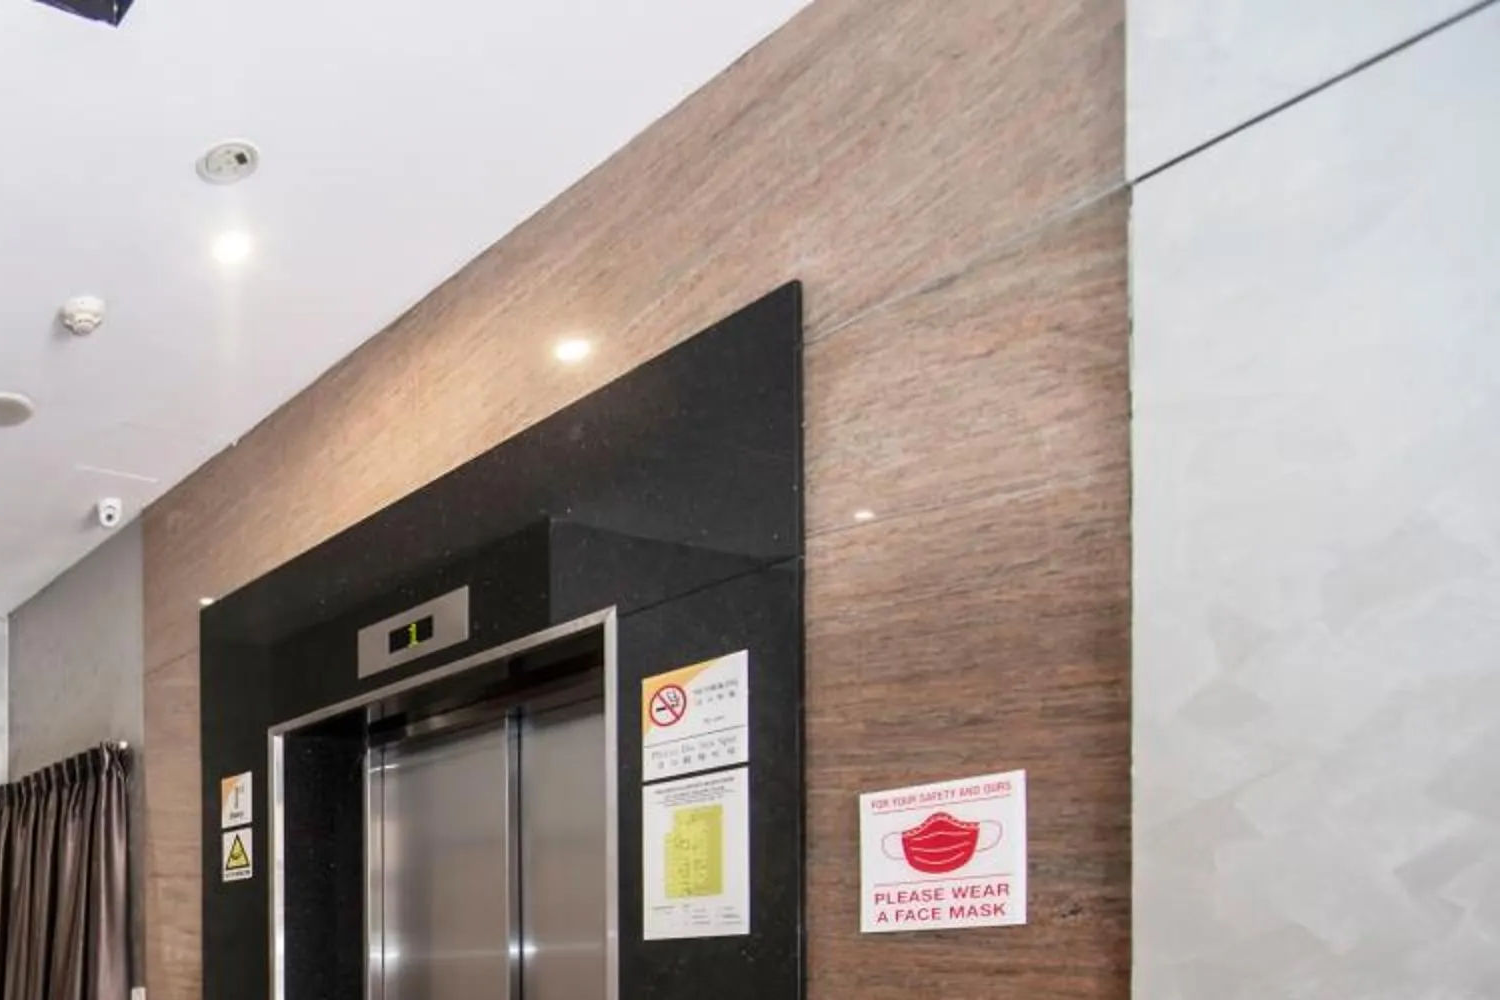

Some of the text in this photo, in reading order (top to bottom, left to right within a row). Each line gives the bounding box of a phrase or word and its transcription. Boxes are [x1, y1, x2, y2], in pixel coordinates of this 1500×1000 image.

[408, 623, 419, 648] 1
[871, 781, 1012, 809] FOR YOUR SAFETY AND OURS
[874, 883, 1010, 905] PLEASE WEAR
[876, 903, 1007, 924] A FACE MASK
